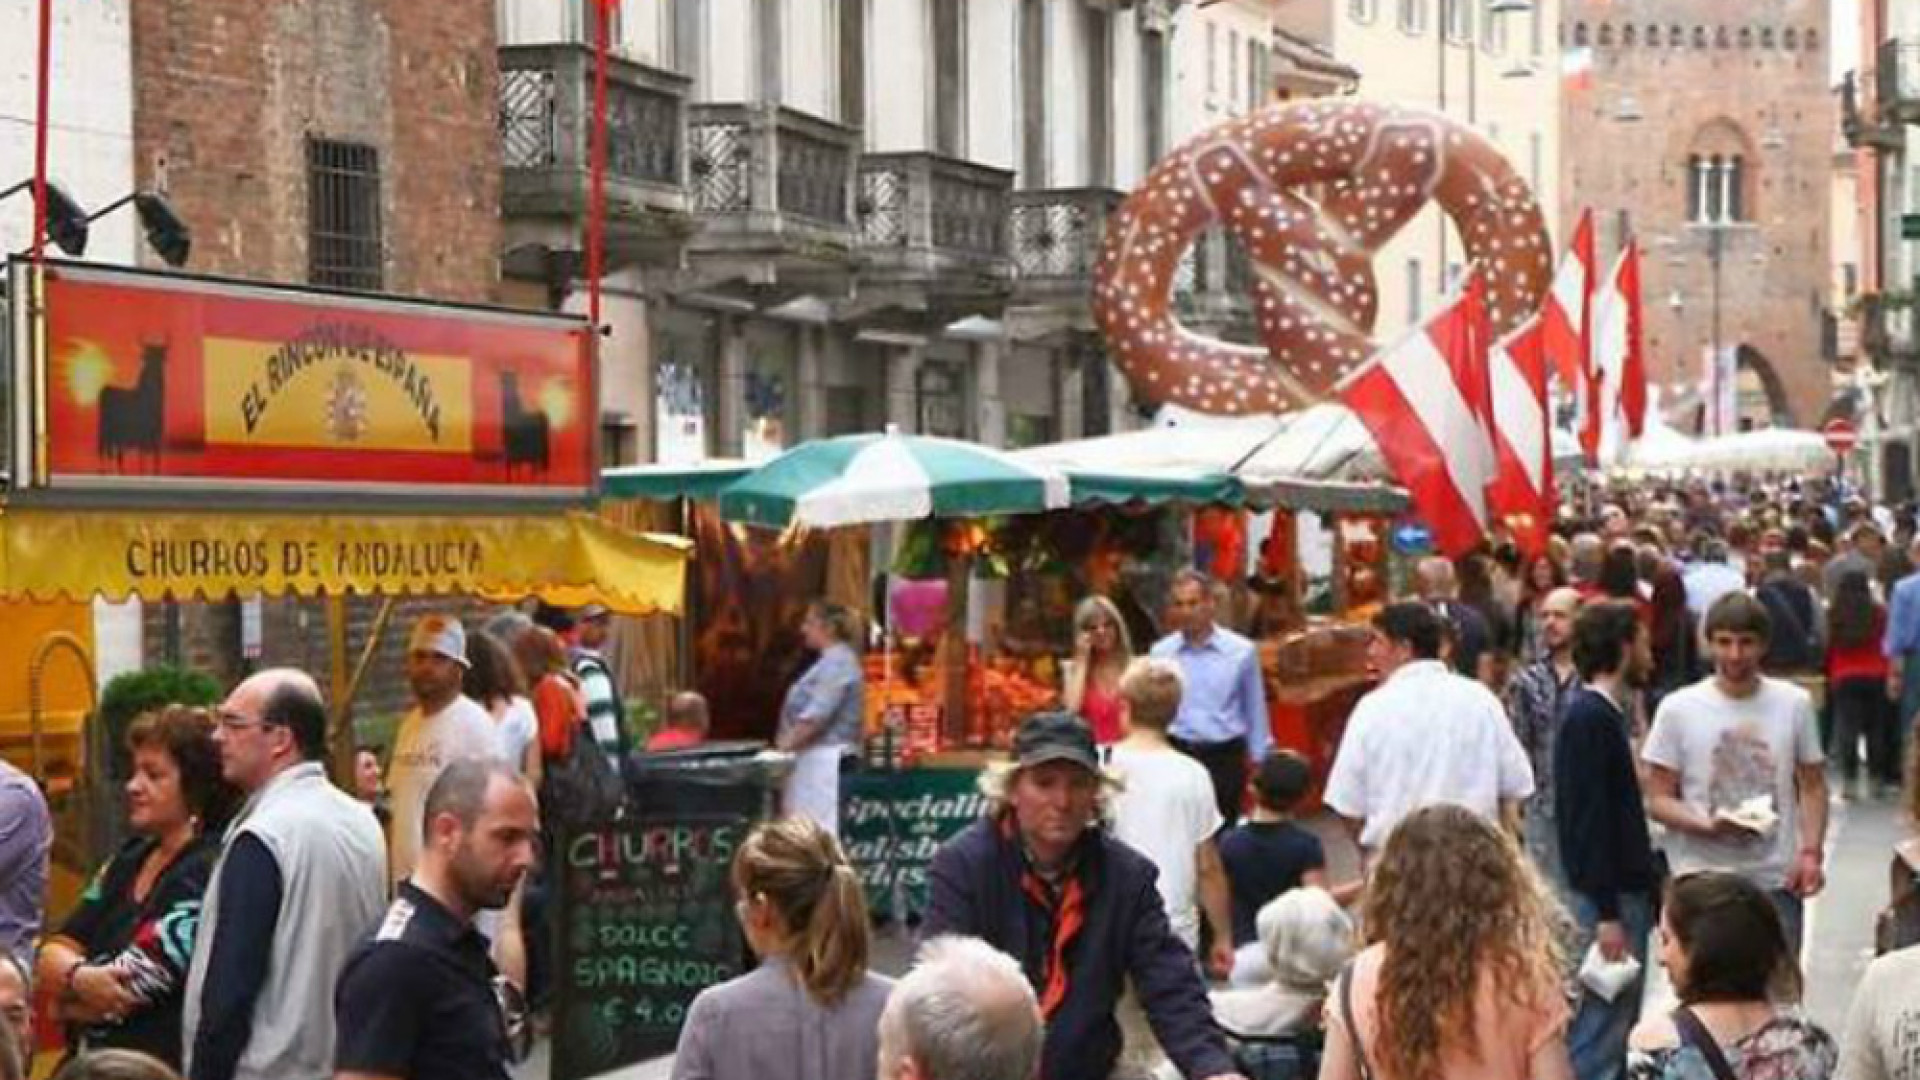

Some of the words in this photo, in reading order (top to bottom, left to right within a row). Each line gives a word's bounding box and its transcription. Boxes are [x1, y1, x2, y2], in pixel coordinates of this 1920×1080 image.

[241, 382, 268, 434] EL
[126, 541, 269, 577] CHURROS
[282, 541, 319, 577] DE
